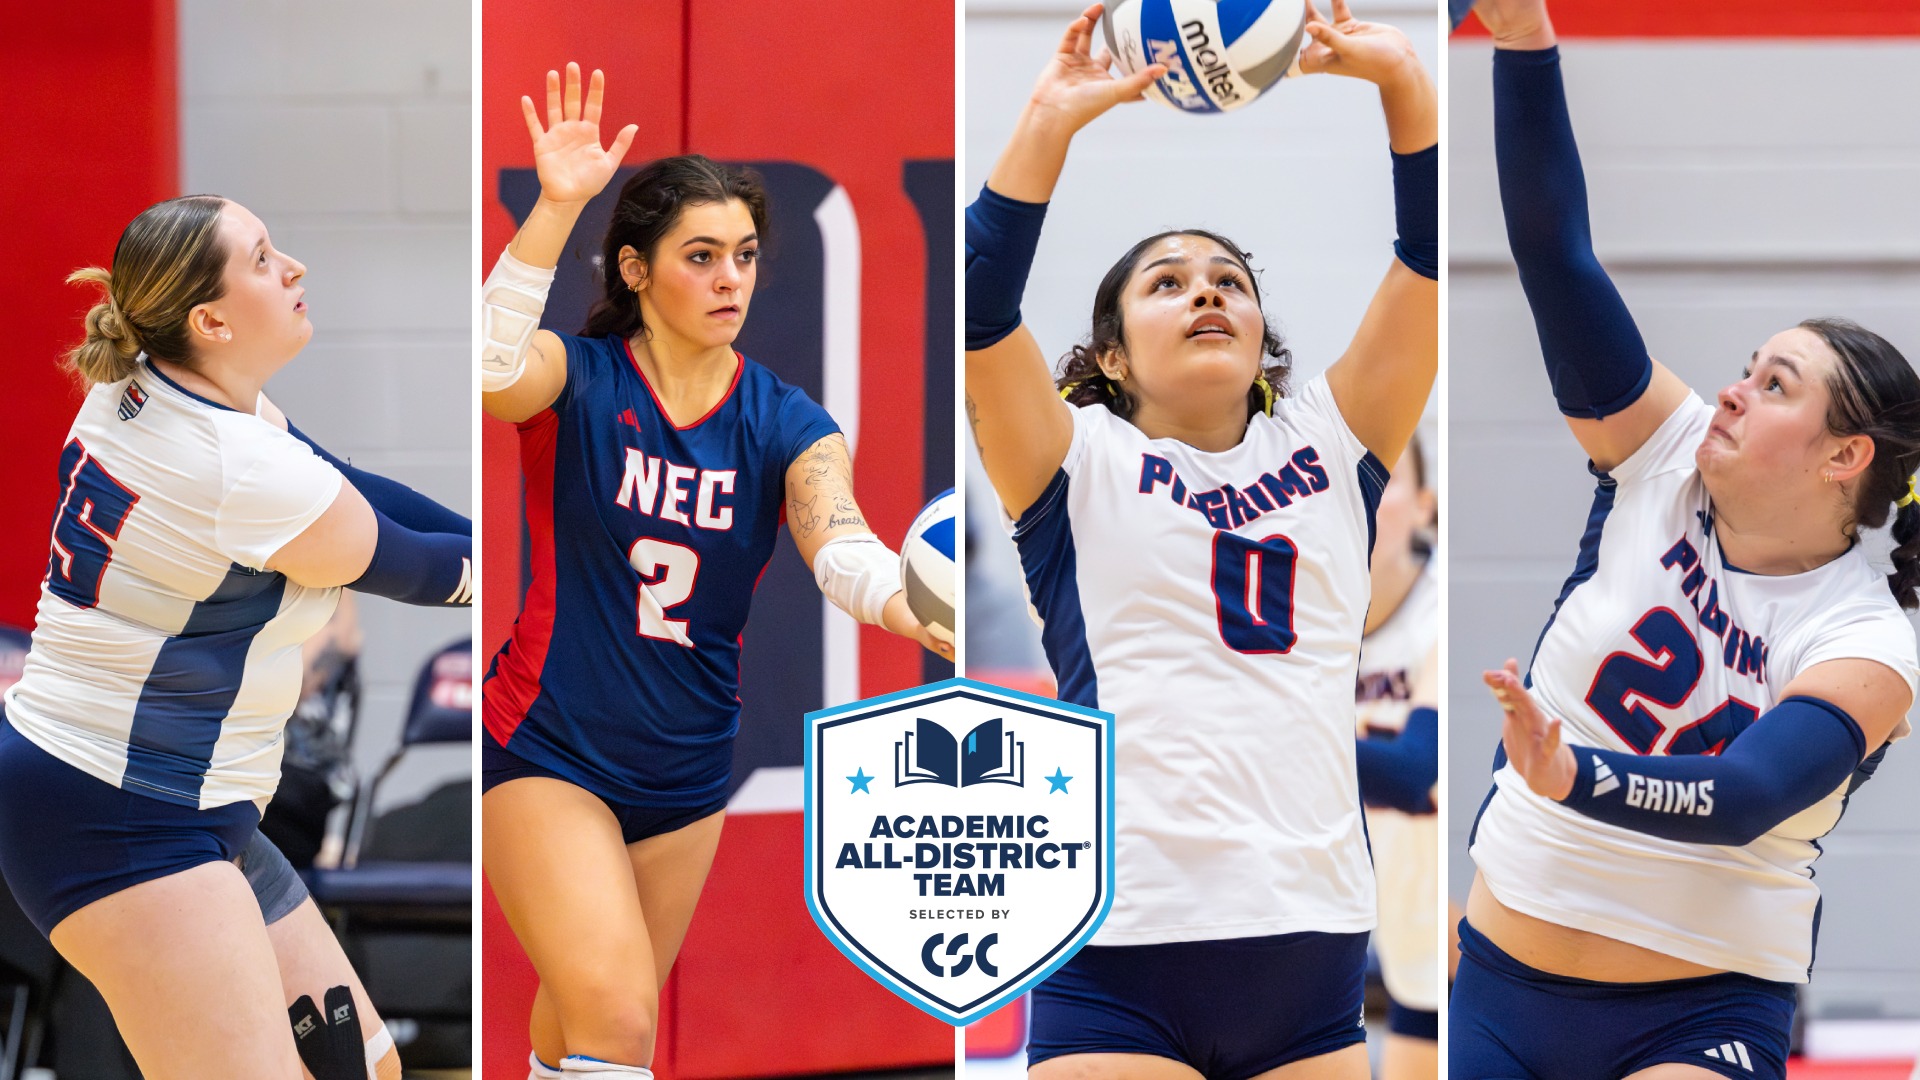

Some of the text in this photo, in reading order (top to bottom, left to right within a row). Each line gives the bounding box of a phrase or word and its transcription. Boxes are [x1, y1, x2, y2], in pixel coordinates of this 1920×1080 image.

[614, 446, 737, 532] NEC
[627, 535, 701, 649] 2
[1211, 530, 1298, 654] 0
[1625, 772, 1714, 816] GRIMS
